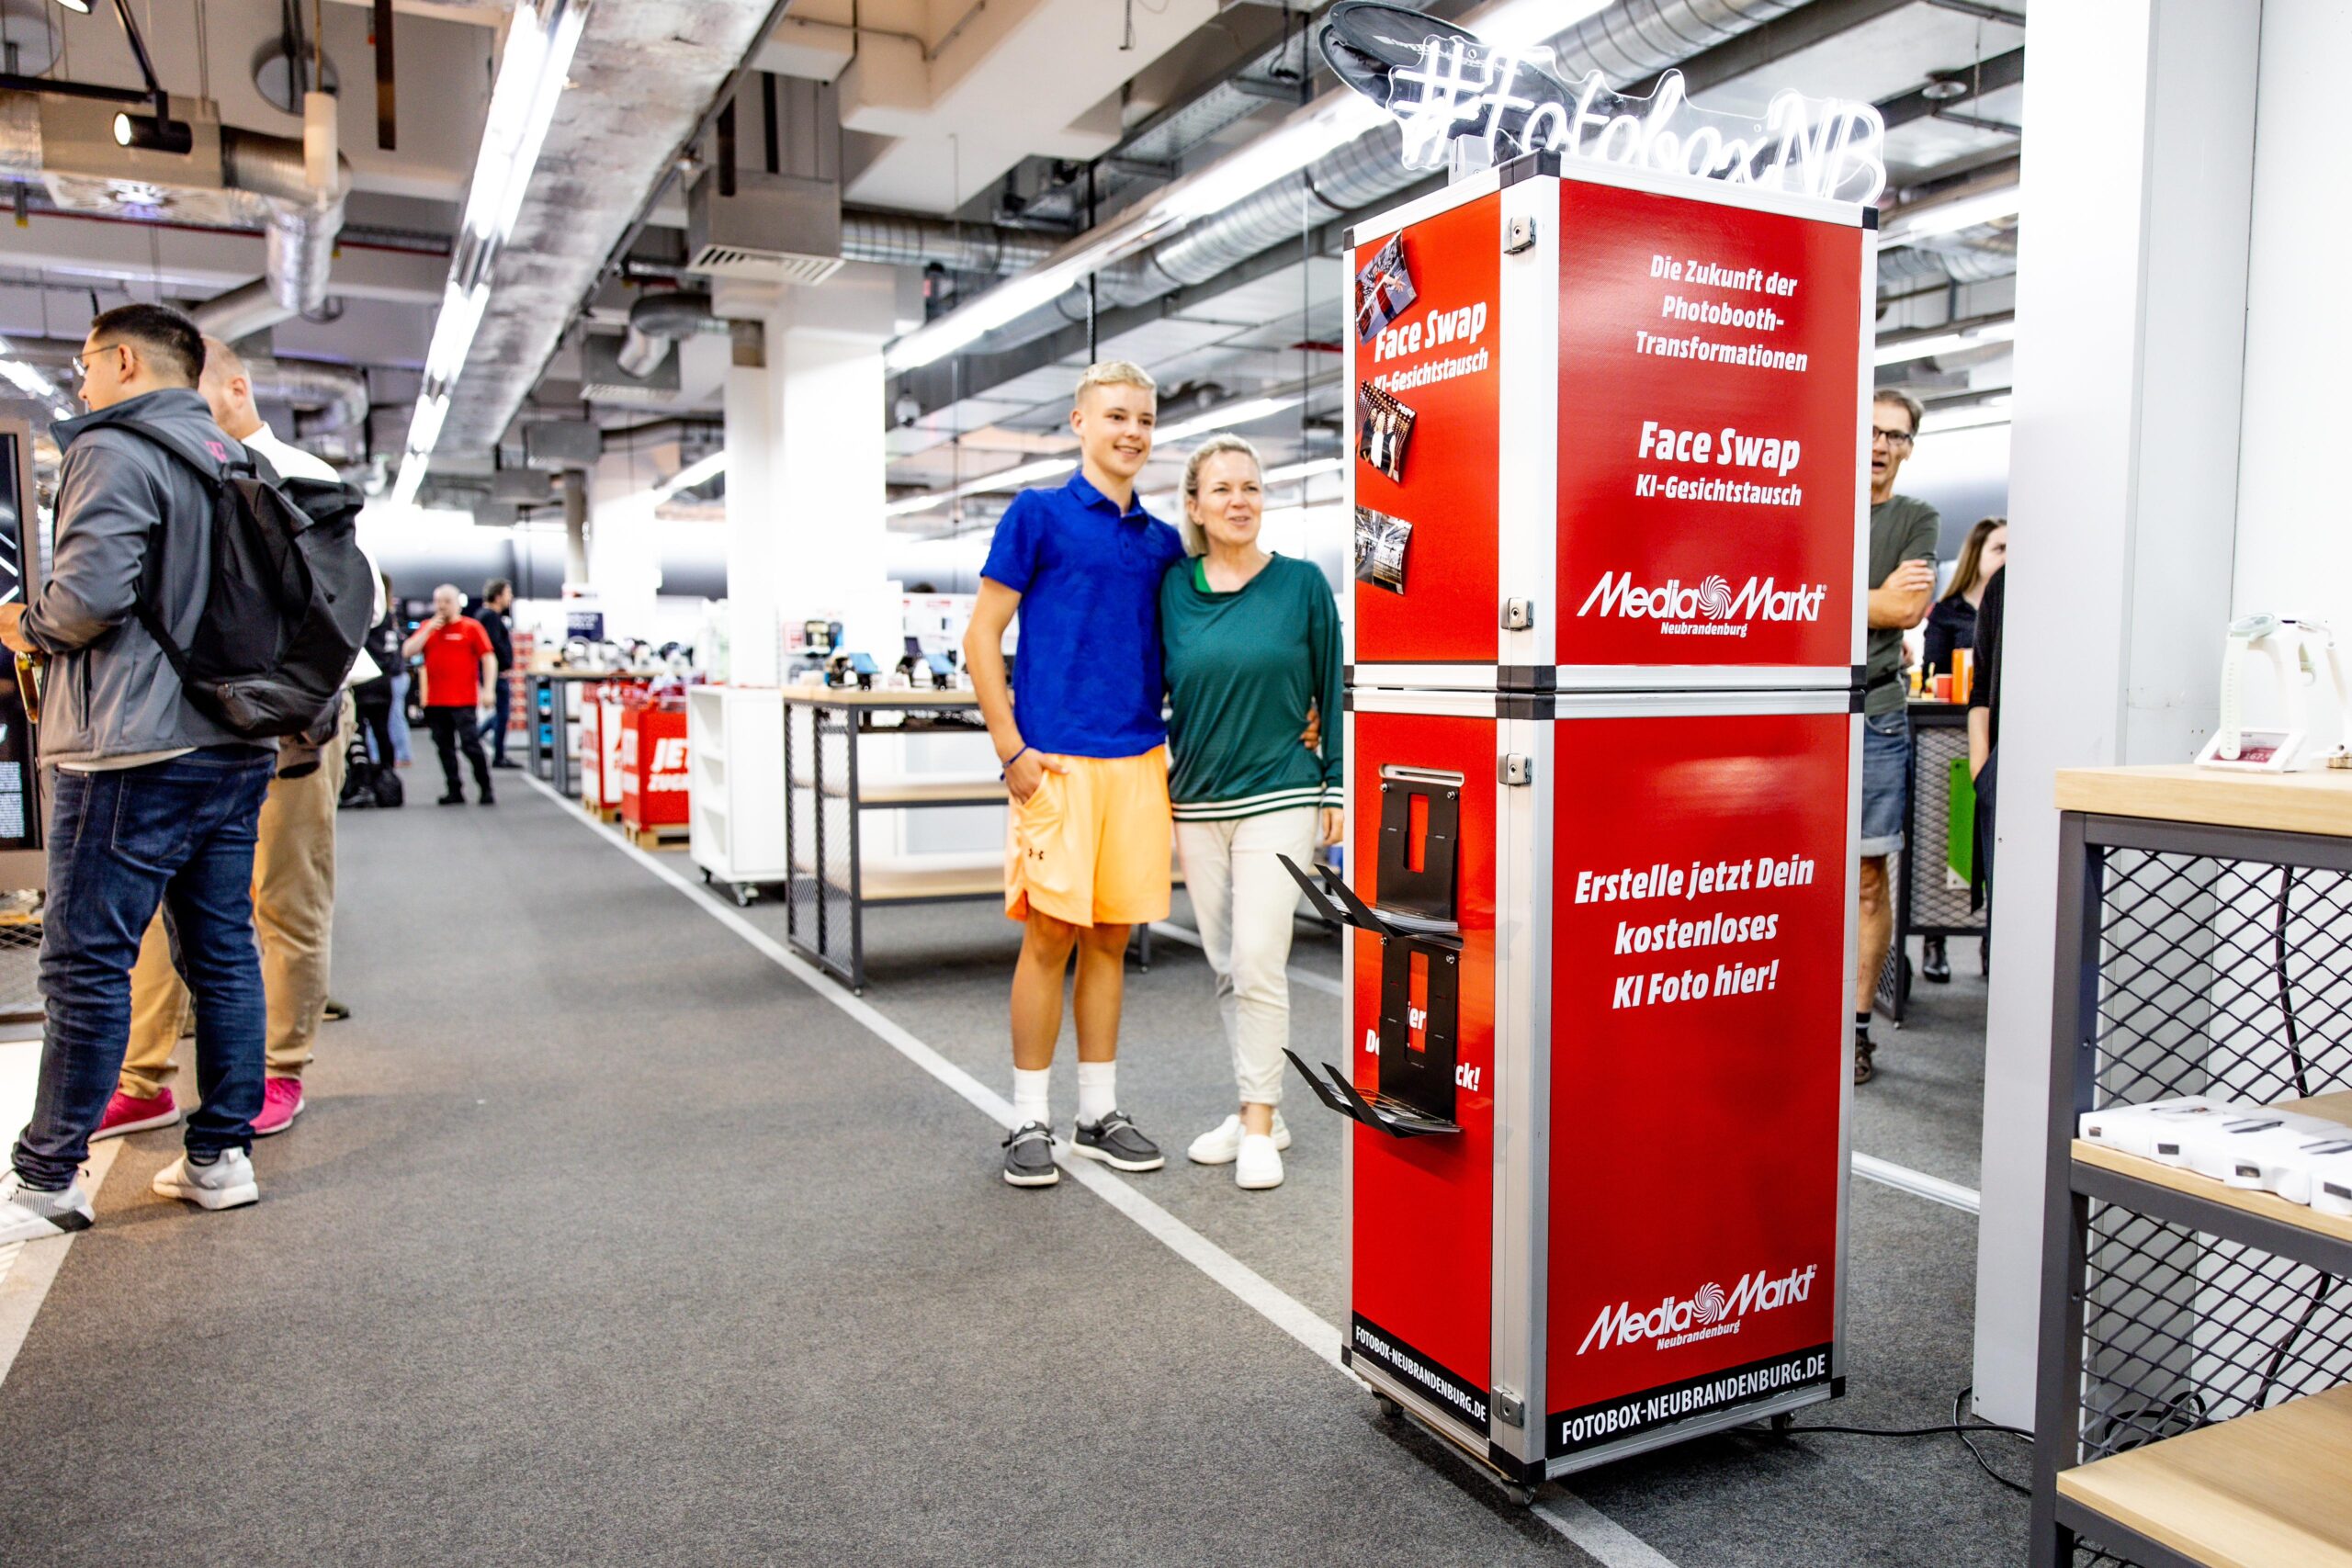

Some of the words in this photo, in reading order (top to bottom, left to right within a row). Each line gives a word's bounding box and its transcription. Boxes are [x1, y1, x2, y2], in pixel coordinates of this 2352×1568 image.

[1650, 254, 1682, 279] Die
[1685, 260, 1763, 293] Zukunft
[1765, 272, 1798, 297] der
[1374, 325, 1422, 363] Face
[1424, 301, 1487, 349] Swap
[1661, 295, 1784, 332] Photobooth-
[1635, 330, 1808, 372] Transformationen
[1638, 421, 1713, 464] Face
[1716, 427, 1801, 477] Swap
[1635, 473, 1802, 506] KI-Gesichtstausch
[1660, 622, 1748, 637] Neubrandenburg
[1574, 863, 1684, 904] Erstelle
[1685, 860, 1753, 901] jetzt
[1755, 854, 1815, 889] Dein
[1613, 912, 1780, 955] kostenloses
[1612, 975, 1645, 1010] KI
[1646, 969, 1710, 1005] Foto
[1713, 959, 1780, 997] hier!
[1657, 1319, 1741, 1350] Neubrandenburg
[1355, 1325, 1487, 1423] FOTOBOX-NEUBRANDENBURG.DE
[1562, 1353, 1826, 1445] FOTOBOX-NEUBRANDENBURG.DE
